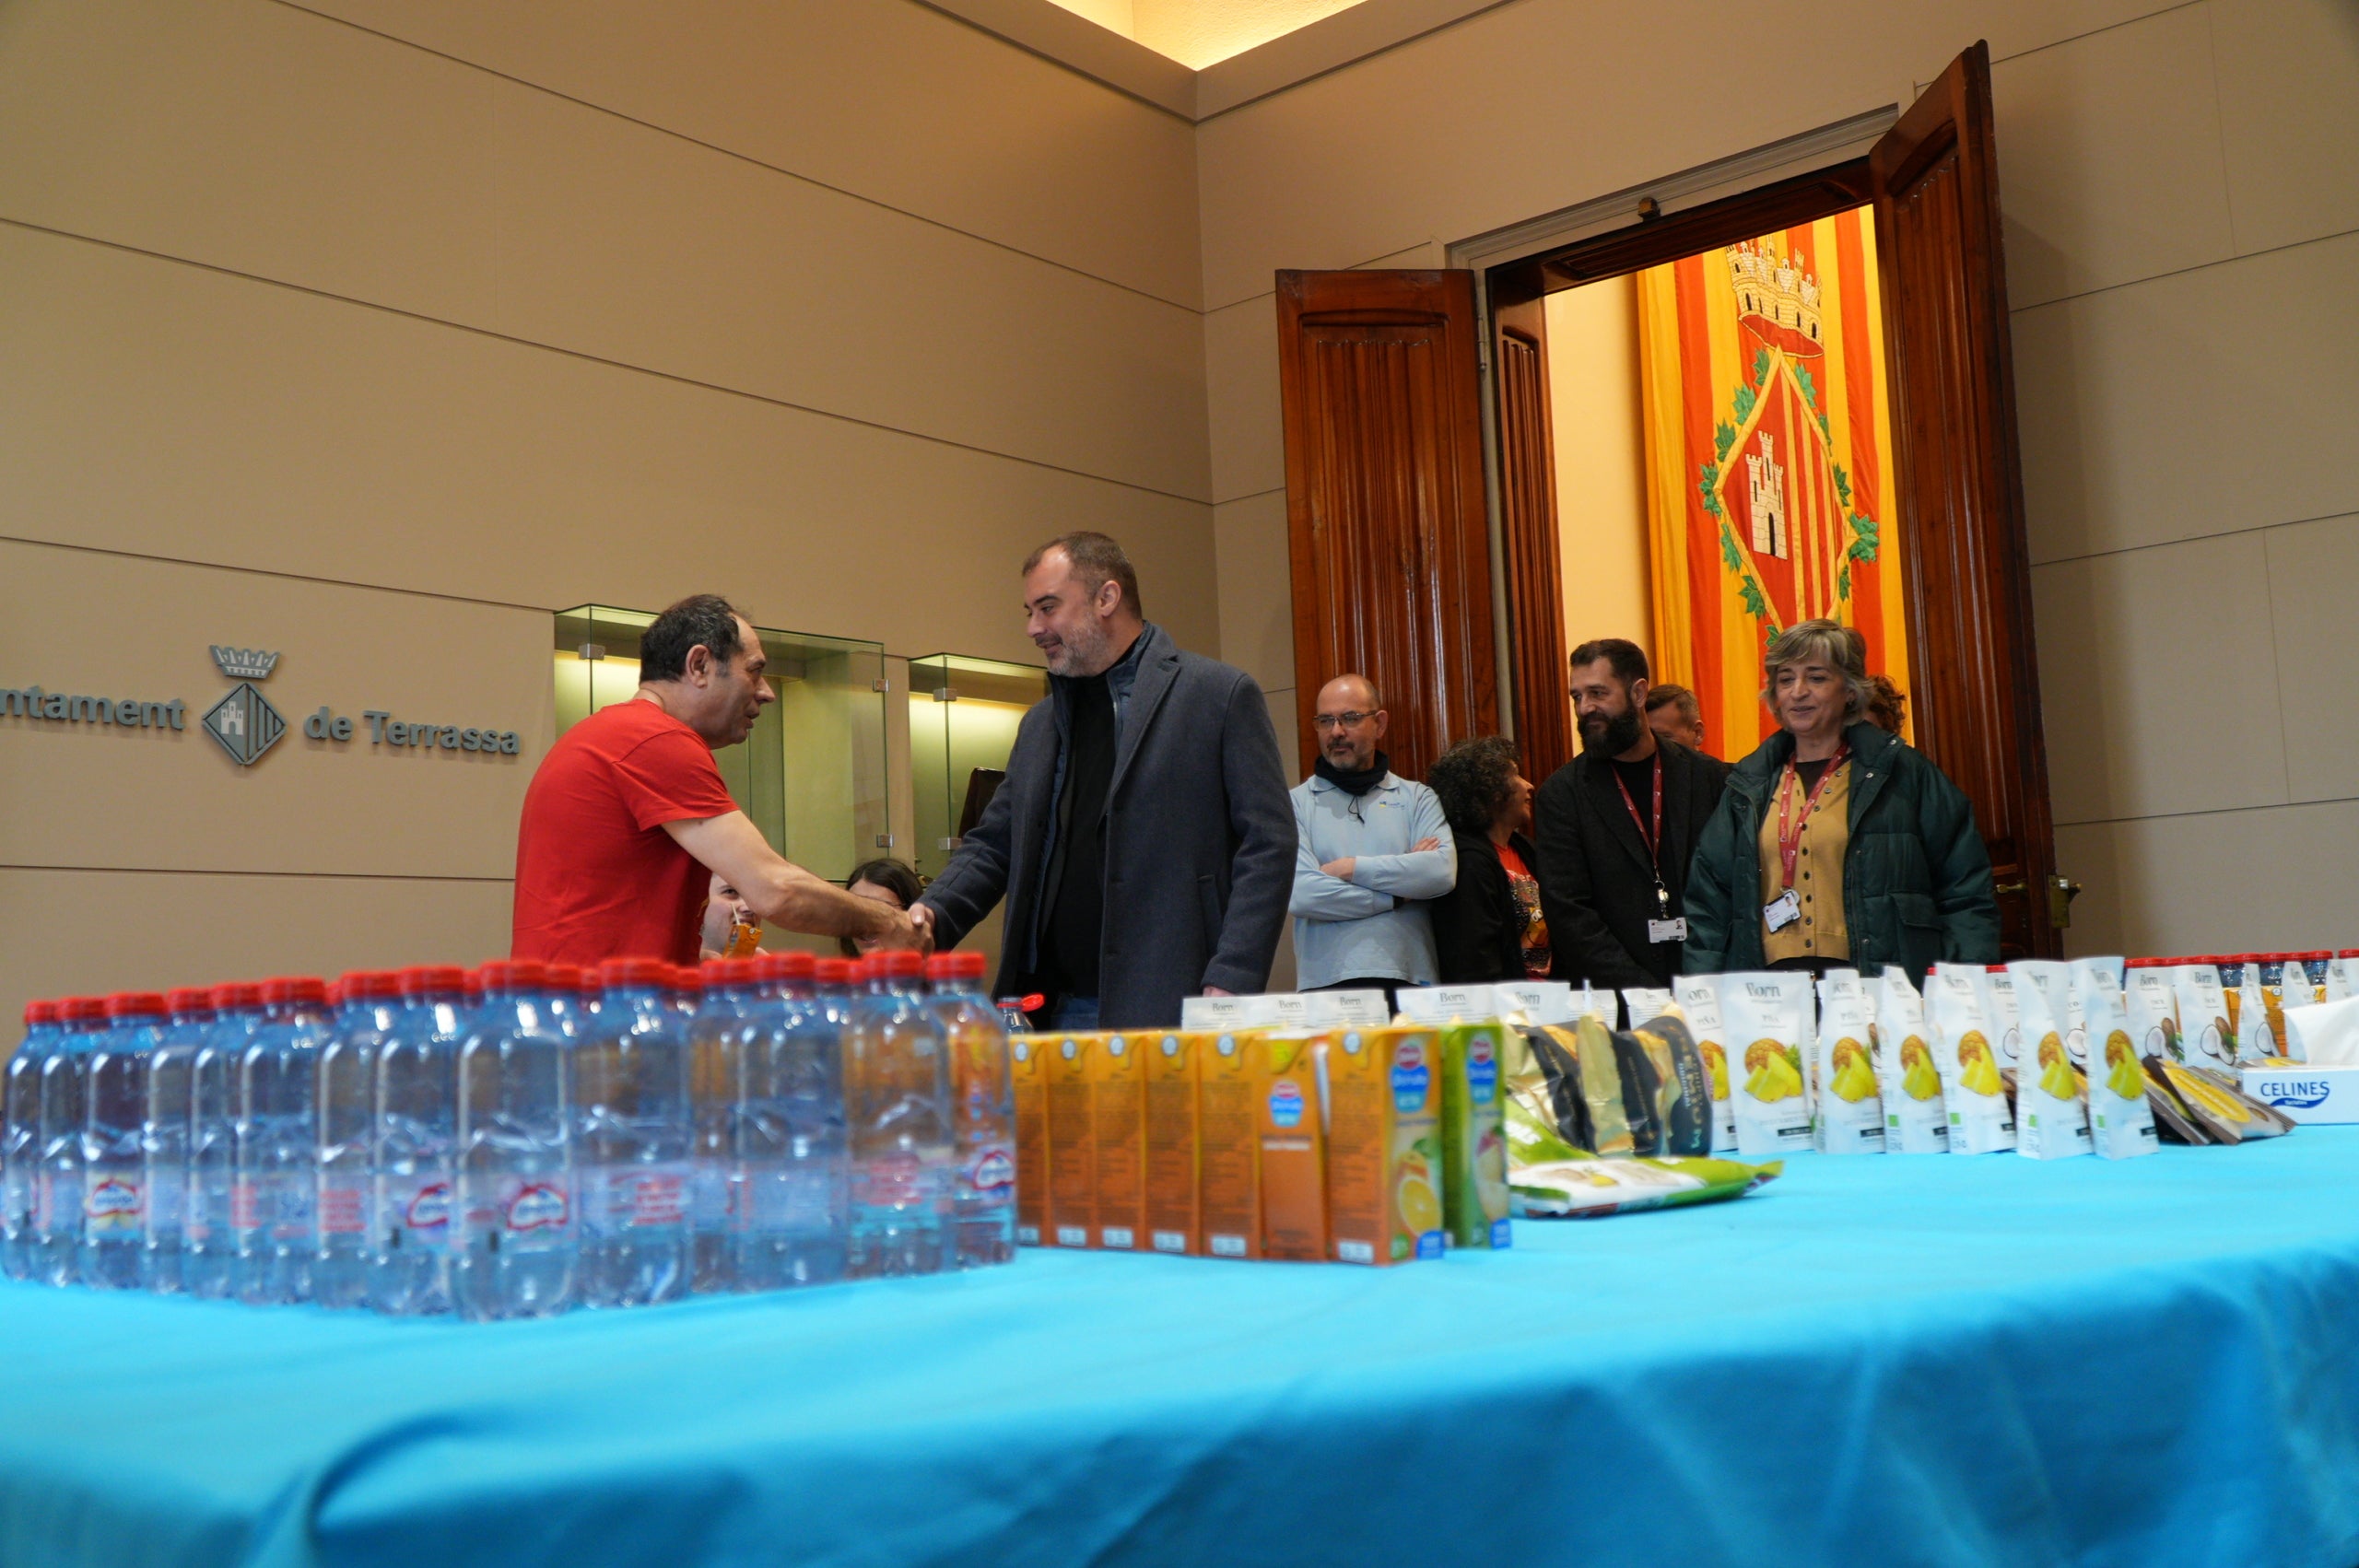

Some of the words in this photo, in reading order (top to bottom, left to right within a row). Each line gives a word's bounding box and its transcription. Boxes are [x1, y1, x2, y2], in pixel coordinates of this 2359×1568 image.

[0, 685, 184, 731] ntament
[304, 707, 353, 741] de
[364, 710, 520, 755] Terrassa
[1744, 982, 1781, 997] Born
[1340, 997, 1361, 1006] Born
[1439, 992, 1465, 1002] Born
[1212, 1002, 1233, 1012] Born
[1279, 1000, 1301, 1010] Born
[2260, 1082, 2330, 1096] CELINES
